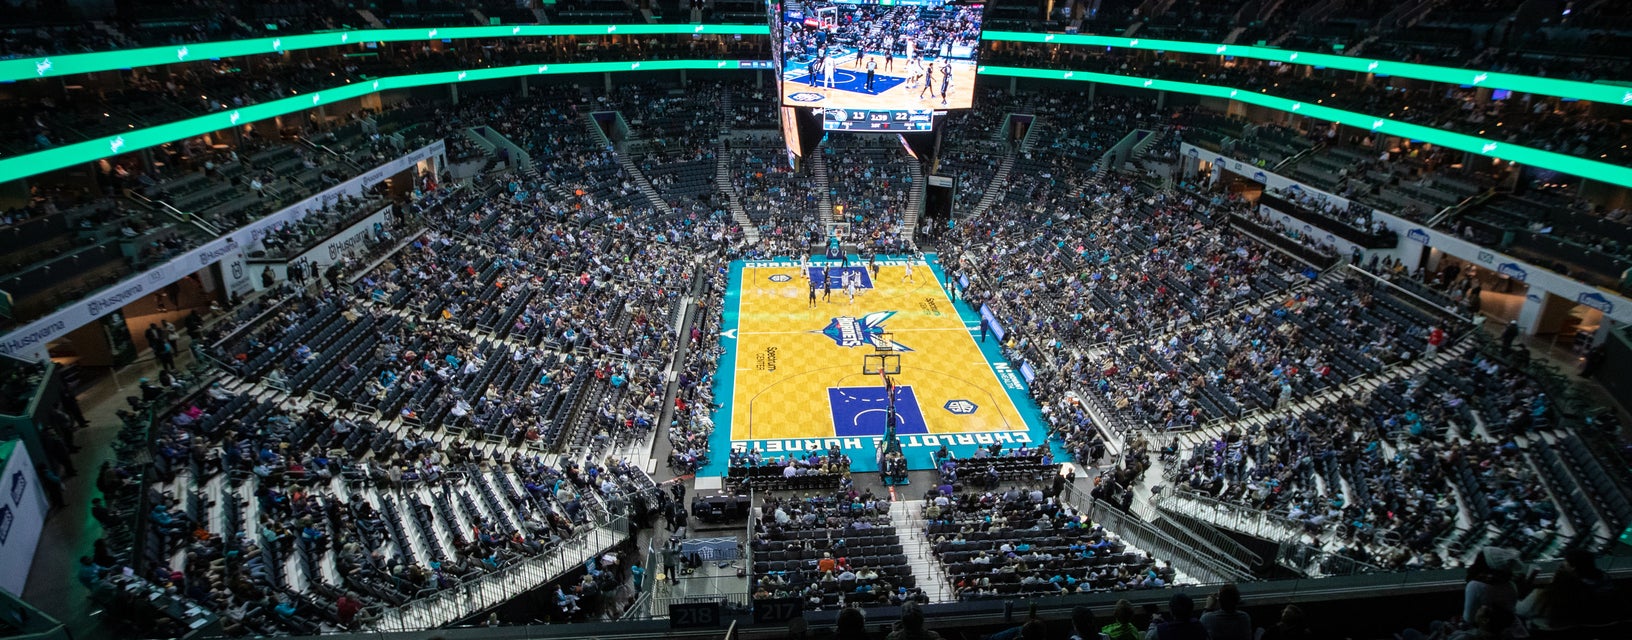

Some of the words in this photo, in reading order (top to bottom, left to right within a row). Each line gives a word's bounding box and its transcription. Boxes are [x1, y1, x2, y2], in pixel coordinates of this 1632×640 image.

[896, 112, 908, 120] 22
[8, 318, 65, 352] Husqvarna
[767, 346, 778, 370] Spectrum
[731, 437, 863, 453] HORNETS
[678, 608, 712, 624] 218
[761, 603, 795, 620] 217
